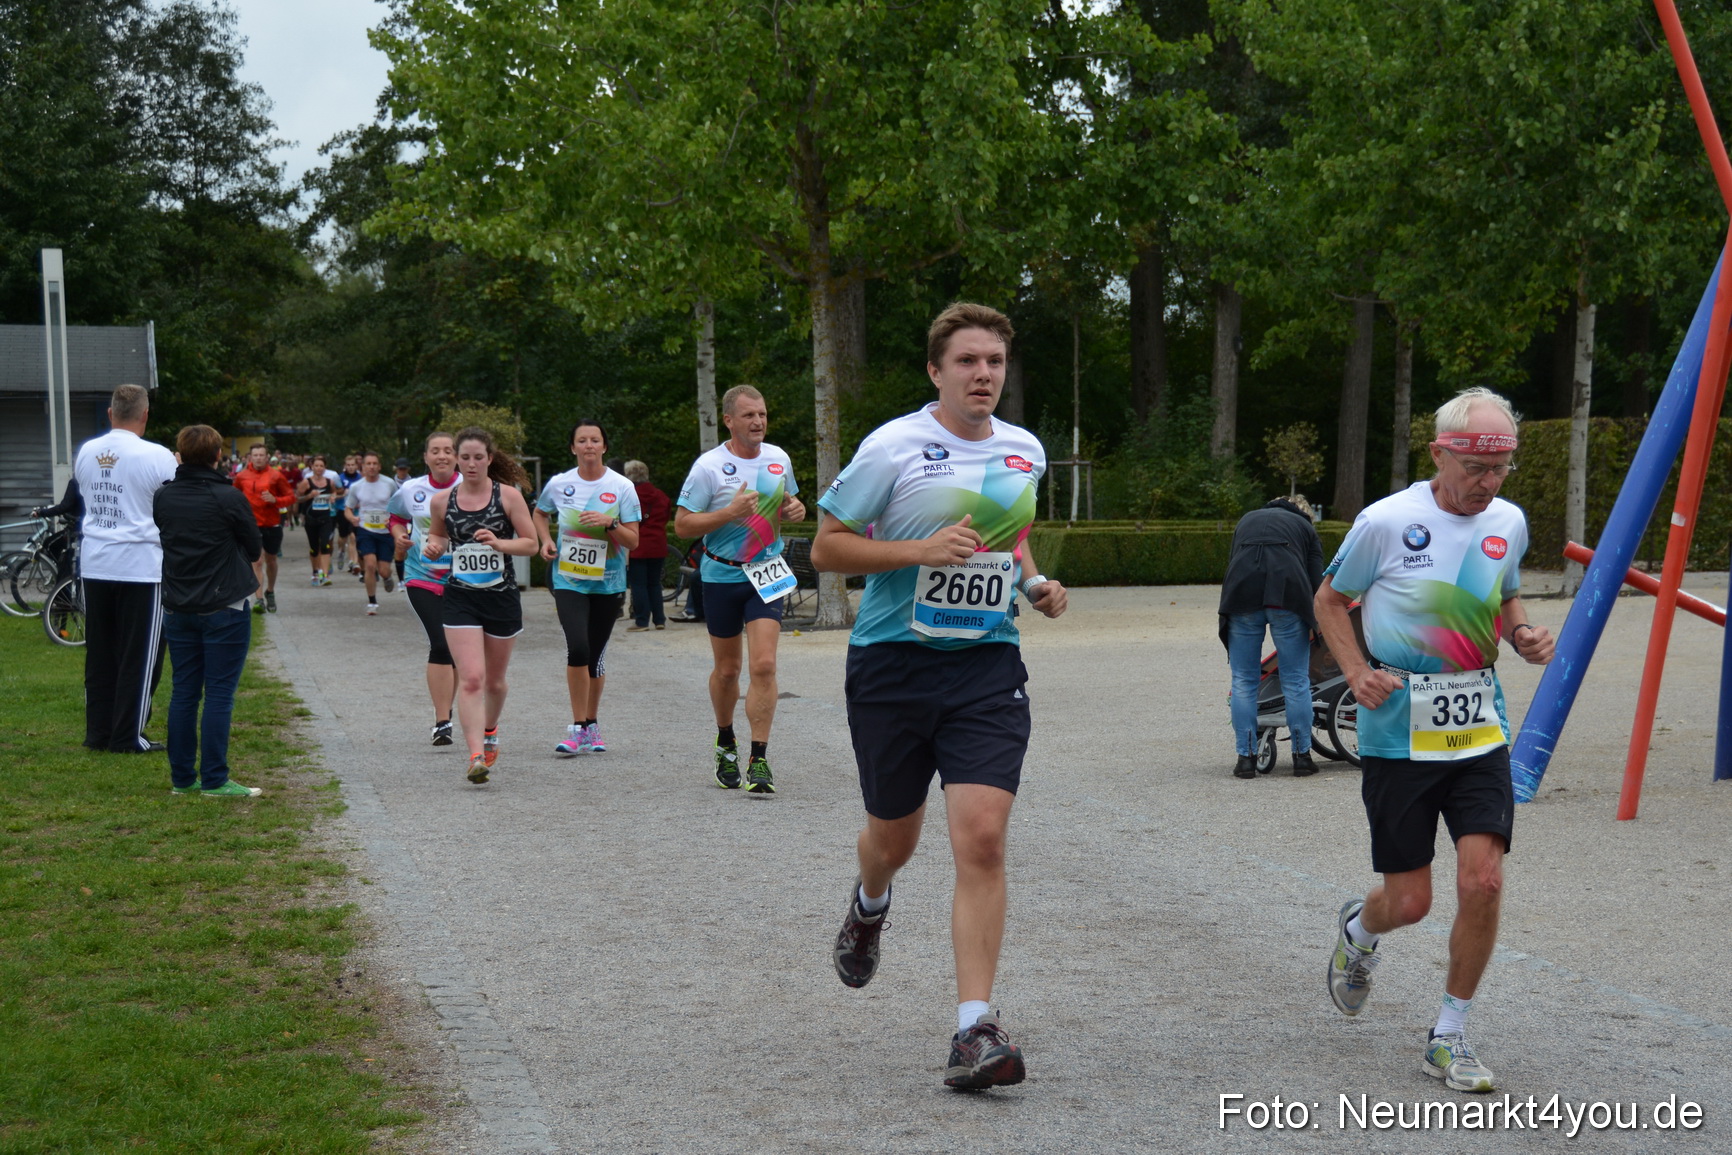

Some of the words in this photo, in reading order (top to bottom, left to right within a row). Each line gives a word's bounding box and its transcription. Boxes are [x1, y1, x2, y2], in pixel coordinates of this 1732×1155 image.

[101, 469, 111, 478] IM
[923, 464, 954, 472] PARTL
[924, 470, 955, 478] Neumarkt
[94, 494, 118, 506] SEINER
[96, 518, 118, 530] JESUS
[370, 515, 380, 524] 38
[1485, 541, 1506, 553] Hervis
[568, 546, 597, 565] 250
[1403, 554, 1433, 563] PARTL
[458, 554, 500, 571] 3096
[1403, 562, 1433, 570] Neumarkt
[573, 566, 588, 575] Anita
[753, 560, 788, 587] 2121
[771, 581, 788, 593] Georg
[925, 570, 1003, 607] 2660
[933, 611, 985, 627] Clemens
[1413, 682, 1446, 692] PARTL
[1447, 679, 1483, 690] Neumarkt
[1431, 691, 1486, 727] 332
[1446, 733, 1473, 748] Willi
